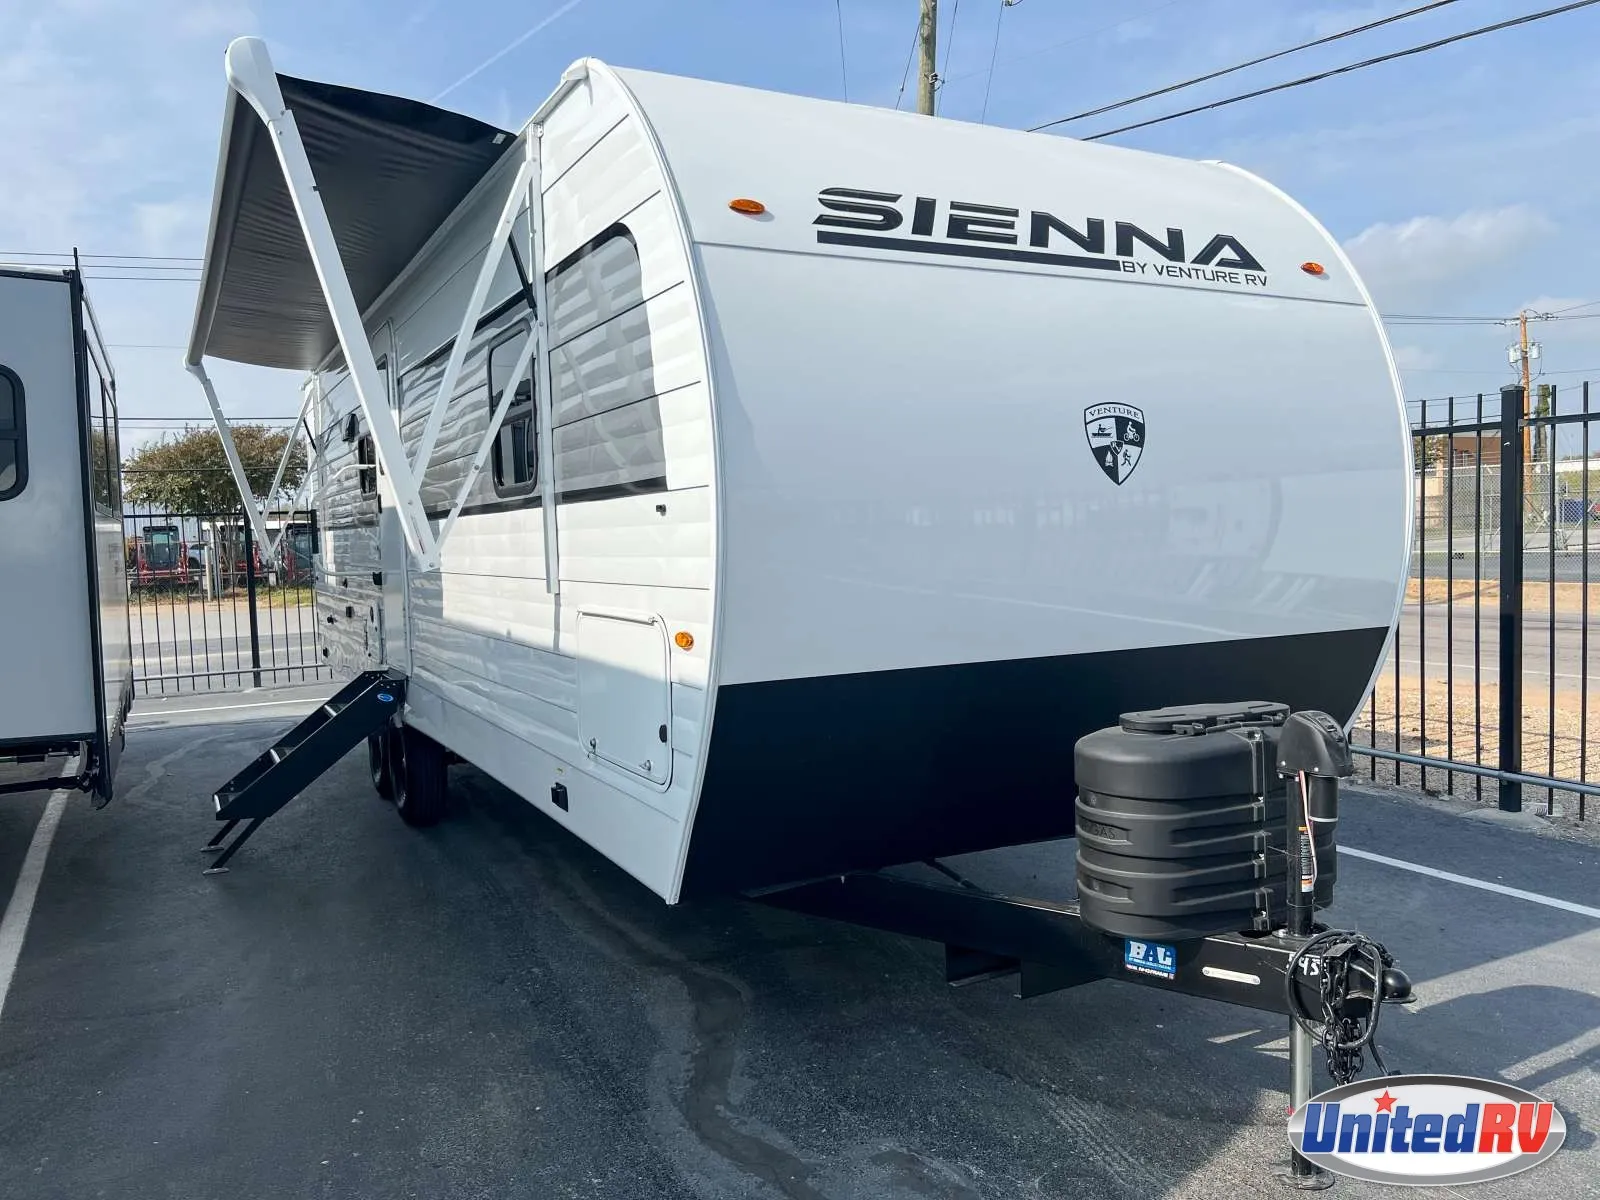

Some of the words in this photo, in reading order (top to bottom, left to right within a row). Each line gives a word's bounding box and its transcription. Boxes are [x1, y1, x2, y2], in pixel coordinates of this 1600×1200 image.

[812, 187, 1265, 272] SIENNA
[1122, 261, 1148, 274] BY
[1153, 263, 1241, 284] VENTURE
[1244, 273, 1267, 286] RV
[1089, 406, 1140, 419] VENTURE
